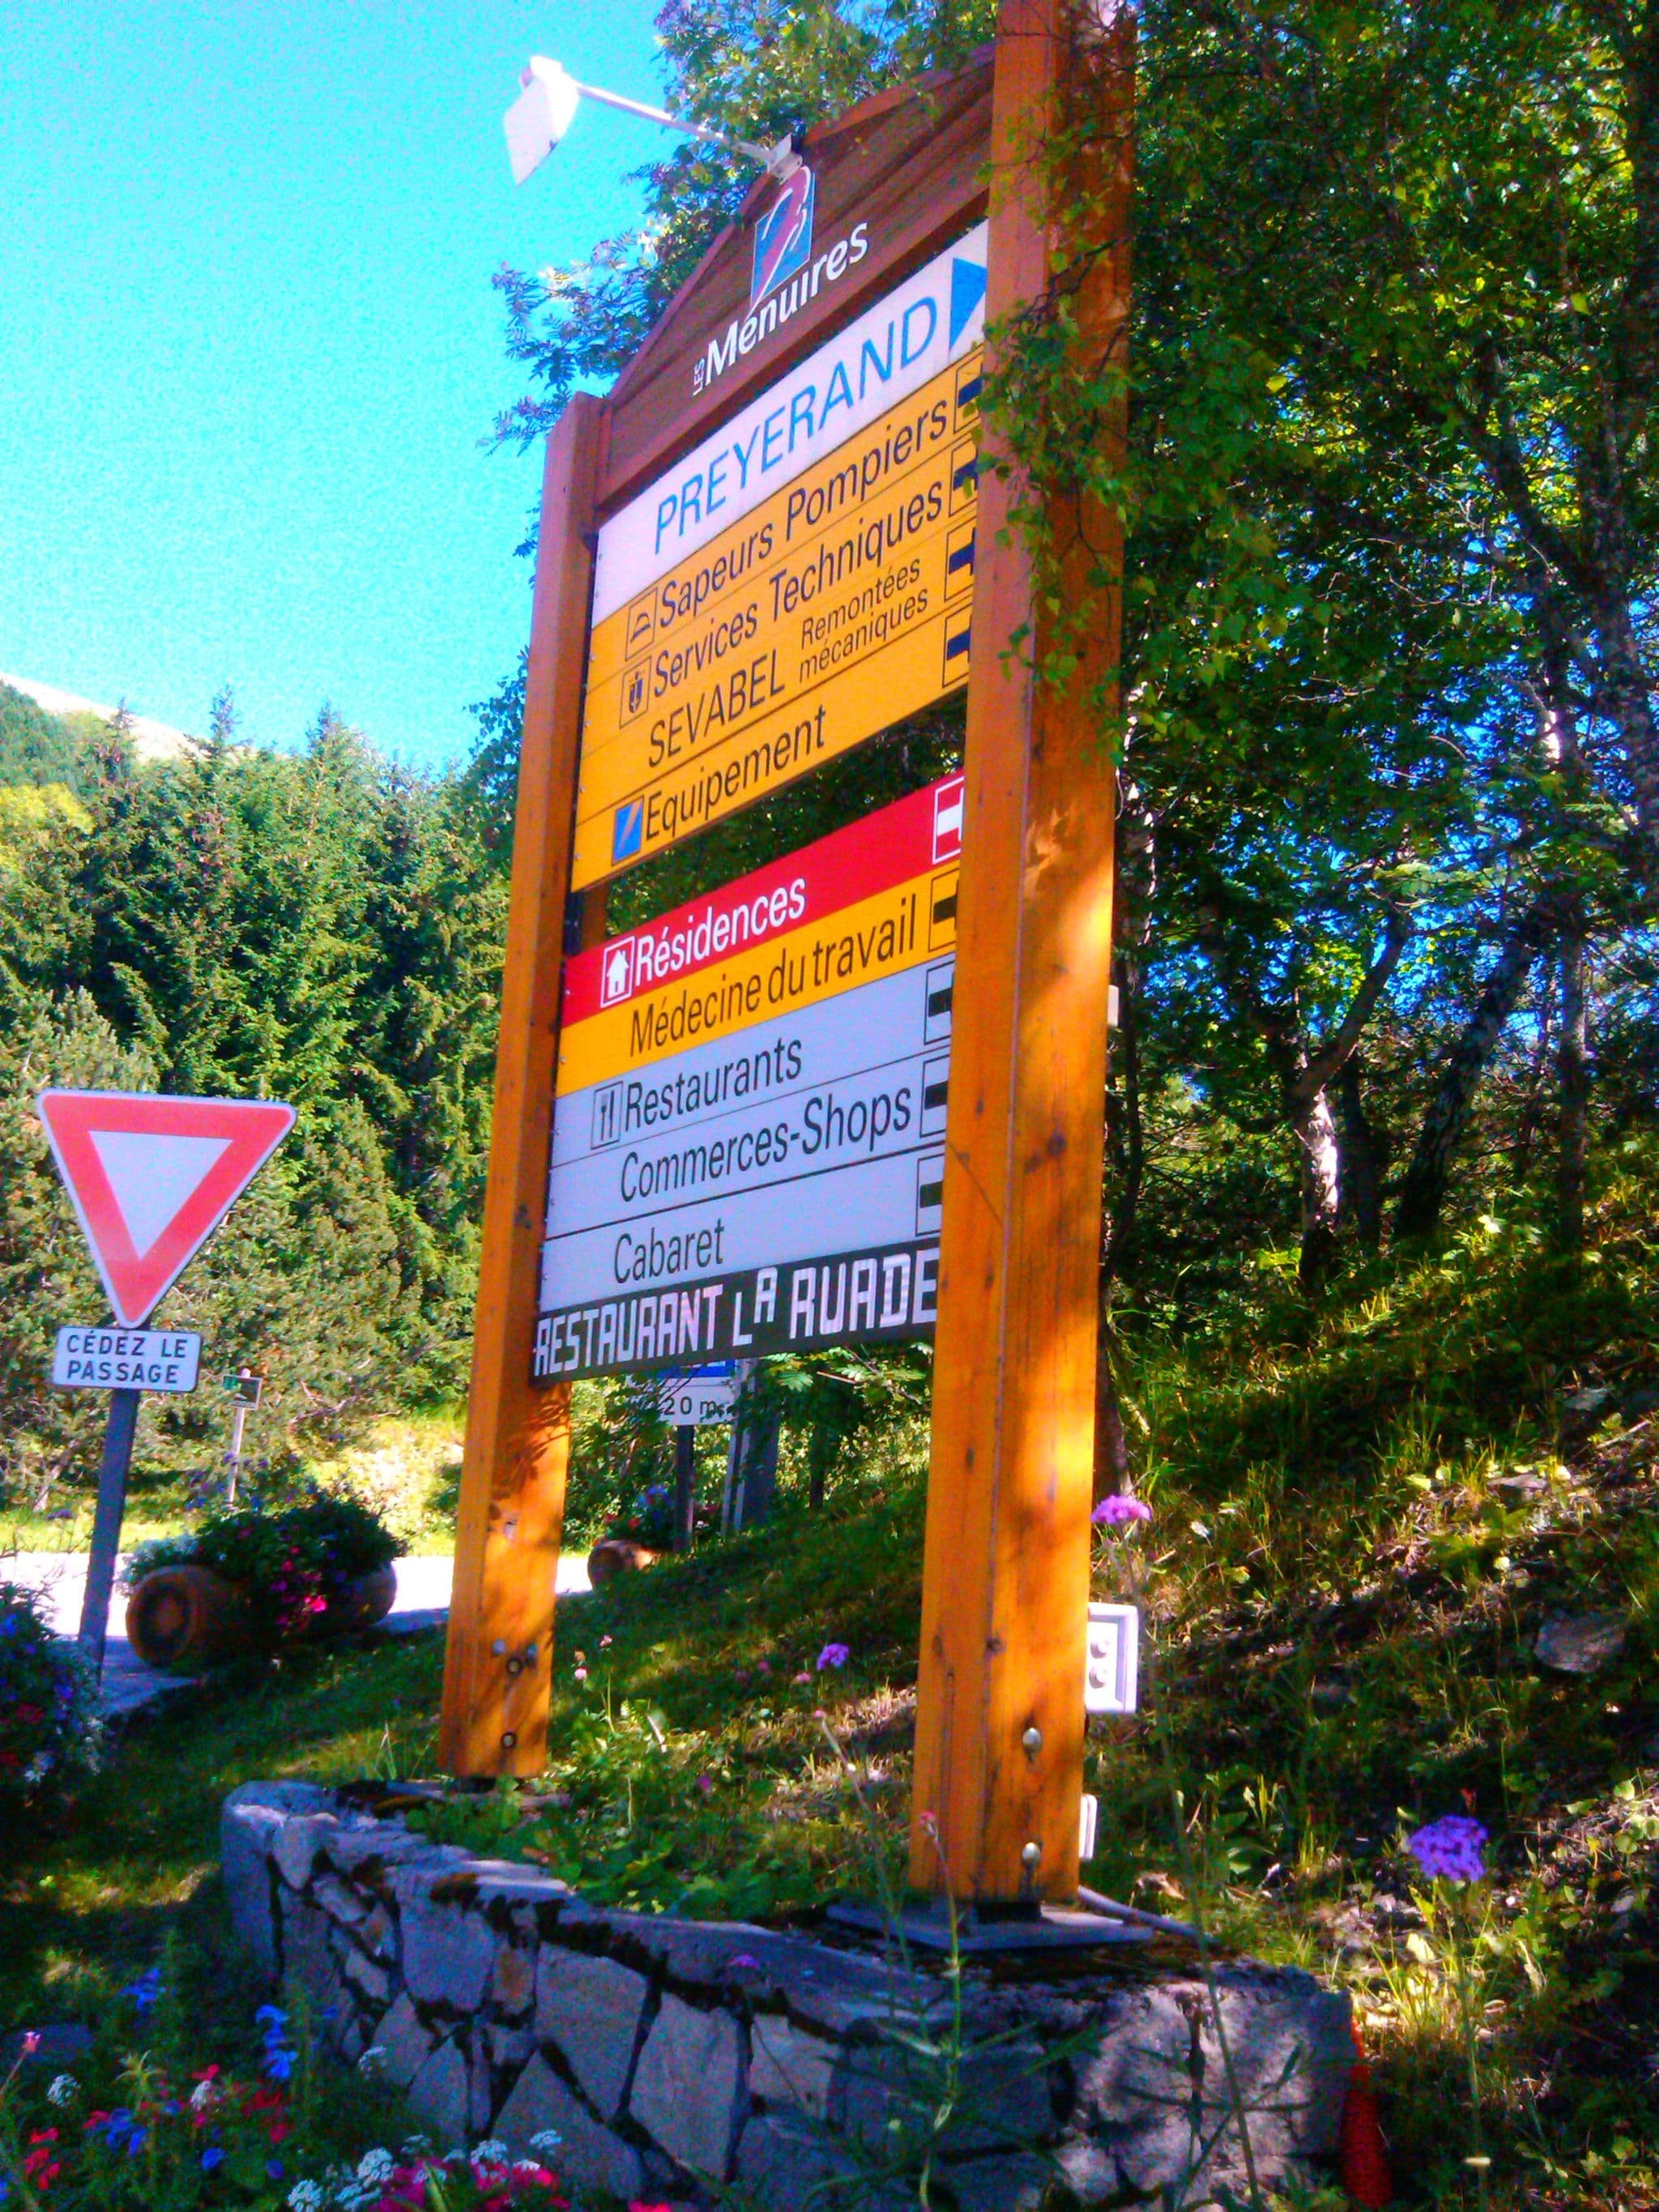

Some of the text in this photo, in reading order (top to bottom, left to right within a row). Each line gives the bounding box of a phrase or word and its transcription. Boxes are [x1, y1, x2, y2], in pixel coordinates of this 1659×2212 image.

[654, 296, 938, 556] PREYERAND
[692, 357, 706, 396] LES
[659, 399, 948, 629] Sapeurs Pompiers
[654, 477, 944, 698] Services Techniques
[799, 588, 928, 684] mécaniques
[801, 557, 921, 650] Remontées
[648, 648, 786, 769] SEVABEL
[645, 703, 826, 843] Equipement
[629, 893, 917, 1057] Médecine du travail
[633, 877, 807, 988] Résidences
[625, 1037, 804, 1133] Restaurants
[620, 1087, 912, 1202] Commerces-Shops
[614, 1218, 726, 1284] Cabaret
[66, 1330, 188, 1359] CÉDEZ LE
[533, 1247, 940, 1377] RESTAURANT LA RUADE
[67, 1360, 180, 1384] PASSAGE
